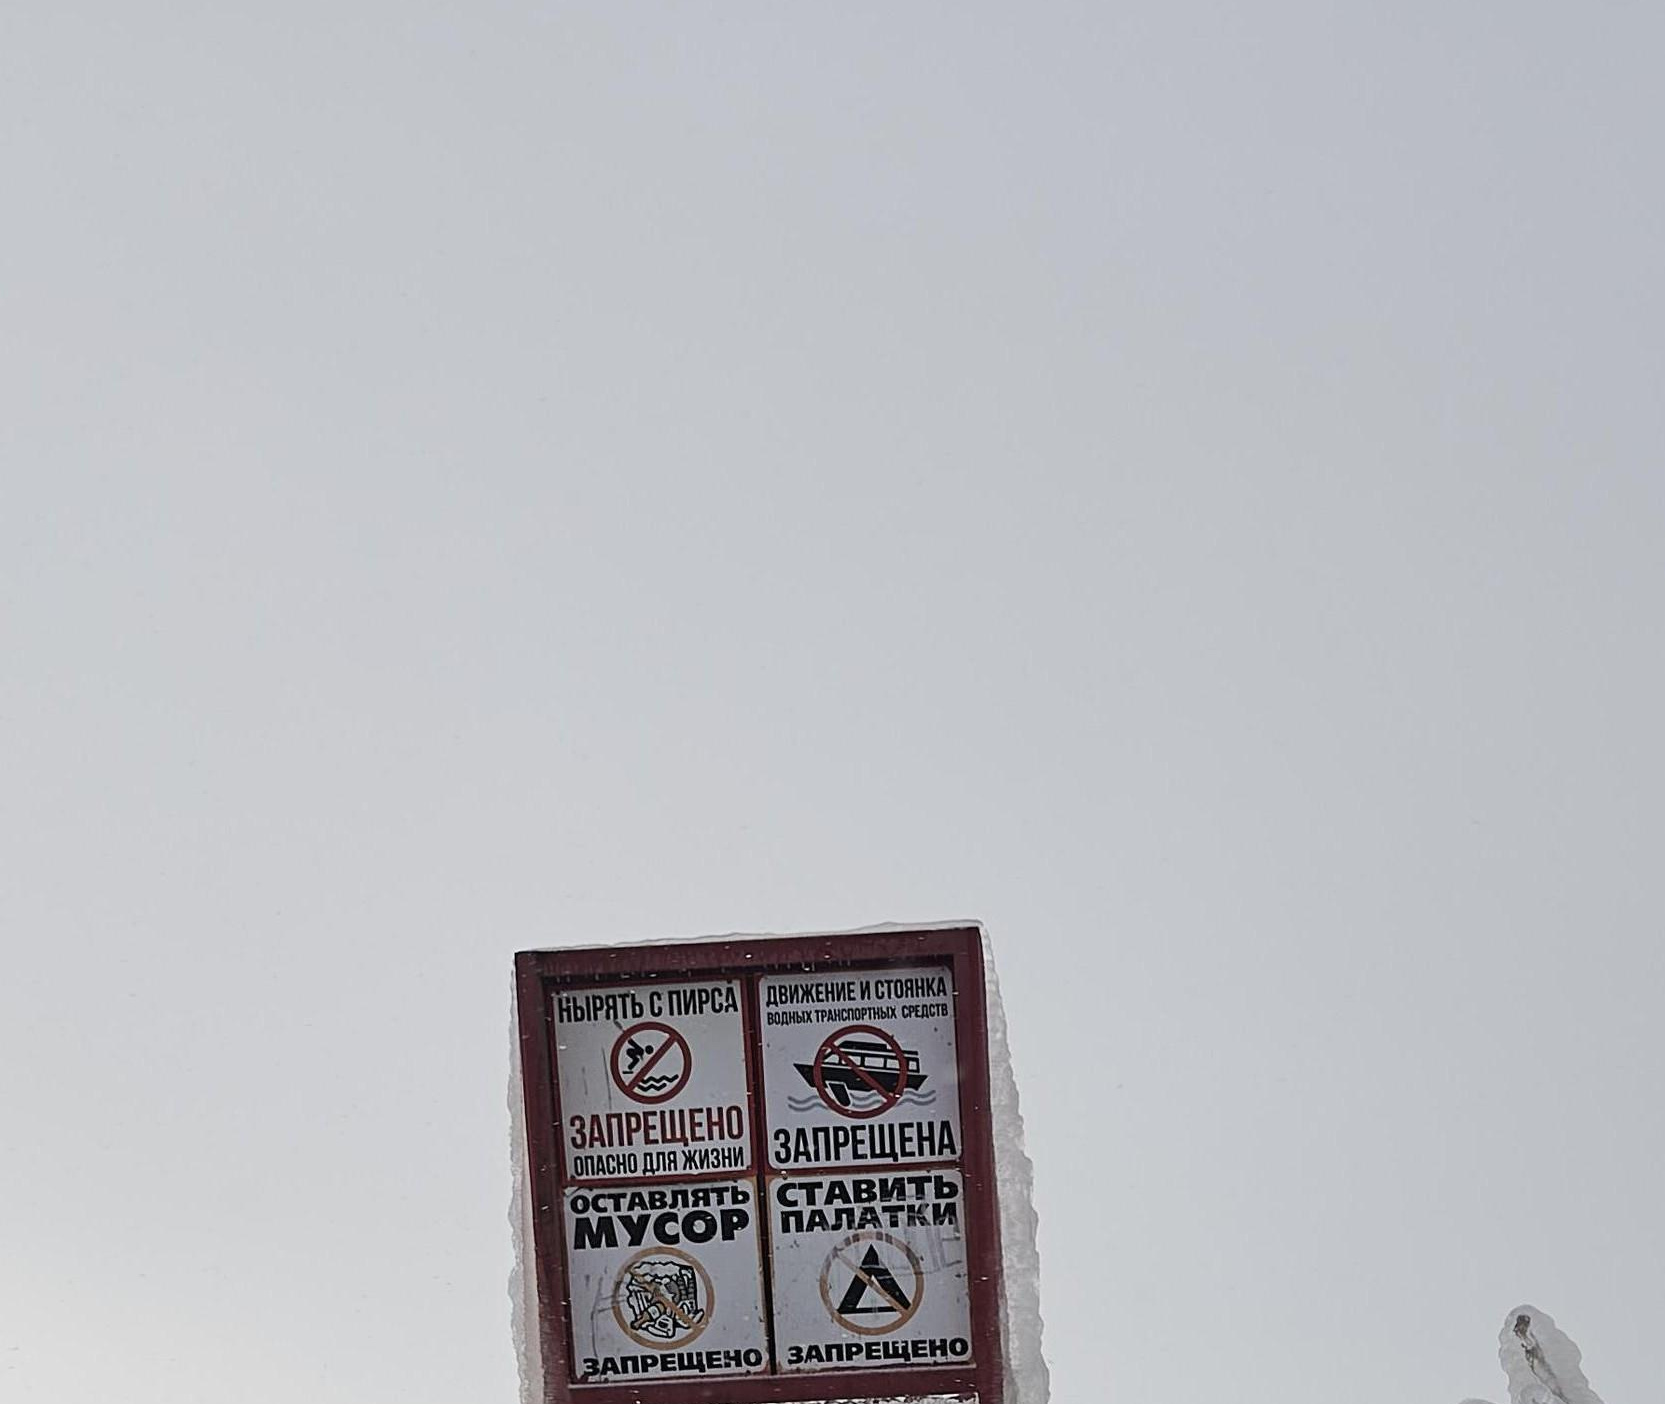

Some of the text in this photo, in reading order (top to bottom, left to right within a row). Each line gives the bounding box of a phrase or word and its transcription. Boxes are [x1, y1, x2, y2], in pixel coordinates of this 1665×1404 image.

[558, 987, 738, 1023] НЫРЯТЬ С ПИРСА
[766, 976, 947, 1007] ДВИЖЕНИЕ И СТОЯНКА
[767, 1003, 948, 1026] ВОДНЫХ ТРАНСПОРТНЫХ СРЕДСТВ
[570, 1105, 744, 1150] ЗАПРЕЩЕНО
[774, 1120, 957, 1163] ЗАПРЕЩЕНА
[573, 1146, 744, 1177] ОПАСНО ДЛЯ ЖИЗНИ
[570, 1186, 750, 1214] ОСТАВЛЯТЬ
[776, 1175, 959, 1207] СТАВИТЬ
[573, 1209, 749, 1250] МУСОР
[780, 1202, 957, 1233] ПАЛАТКИ
[583, 1348, 763, 1376] ЗАПРЕЩЕНО
[787, 1337, 968, 1364] ЗАПРЕЩЕНО
